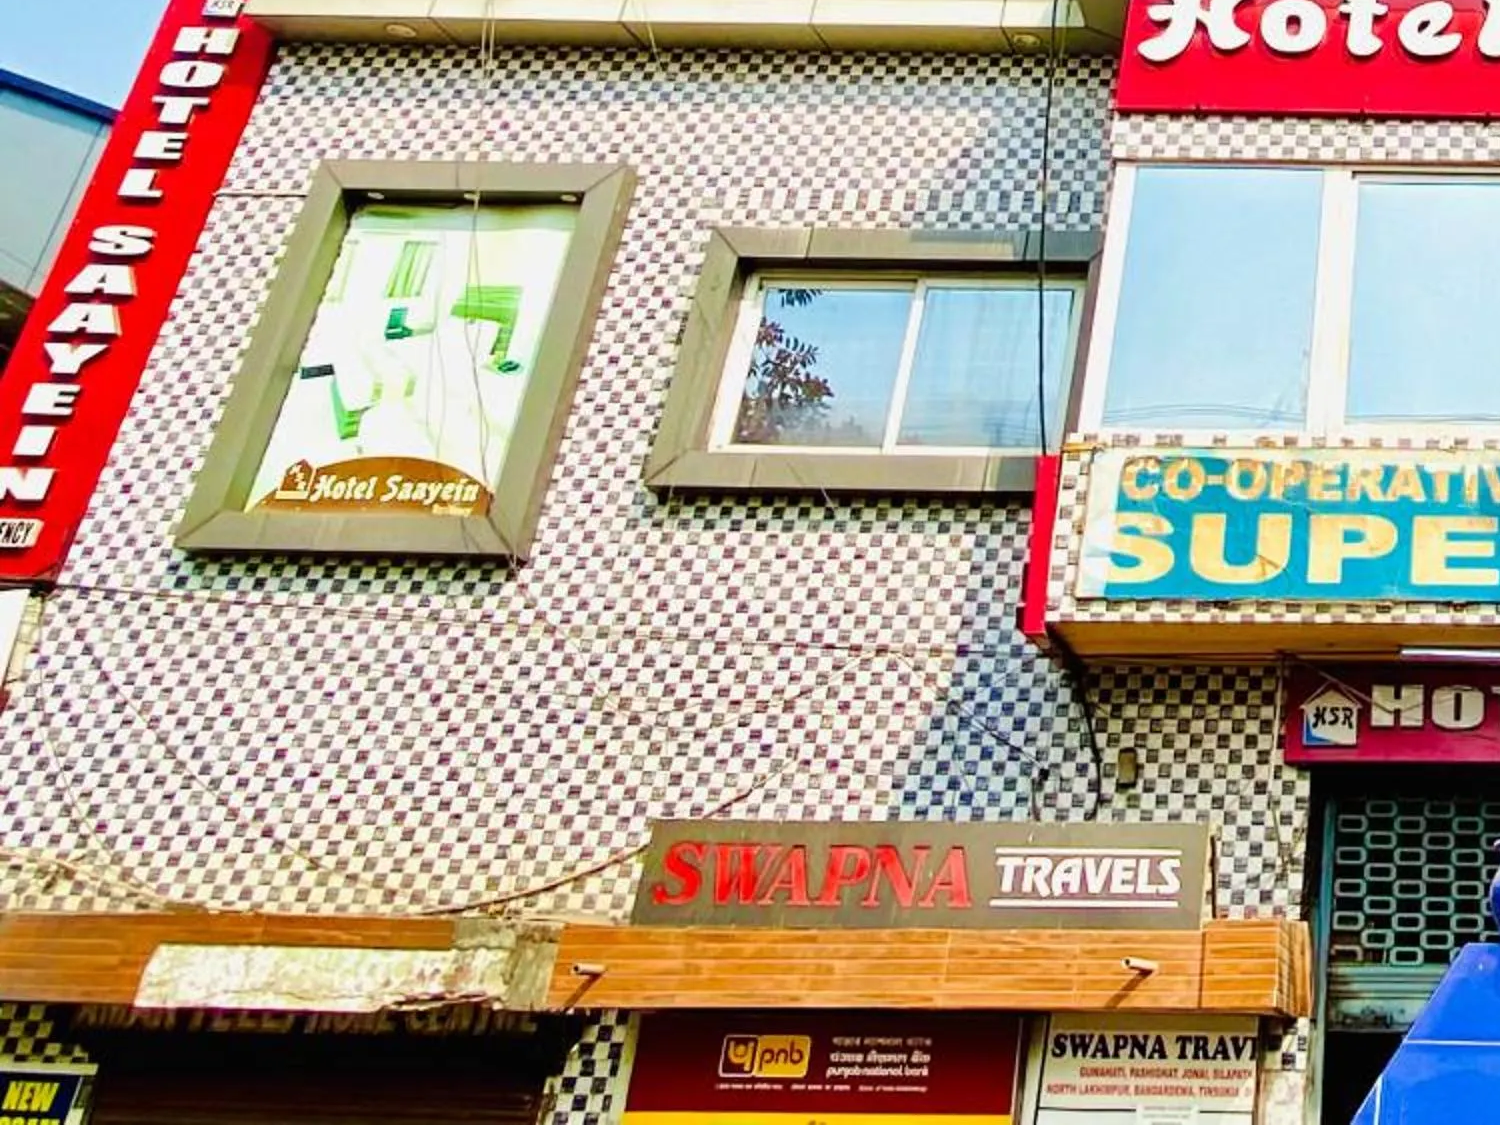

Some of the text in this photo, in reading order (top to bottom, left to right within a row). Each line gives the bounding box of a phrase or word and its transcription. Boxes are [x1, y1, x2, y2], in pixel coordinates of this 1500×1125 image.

[0, 26, 241, 501] HOTEL SAAYEIN
[310, 474, 480, 504] Hotel Saayein
[653, 840, 1181, 909] SWAPNA TRAVELS
[760, 1041, 804, 1072] pnb
[1051, 1032, 1168, 1060] SWAPNA
[2, 1081, 61, 1112] NEW
